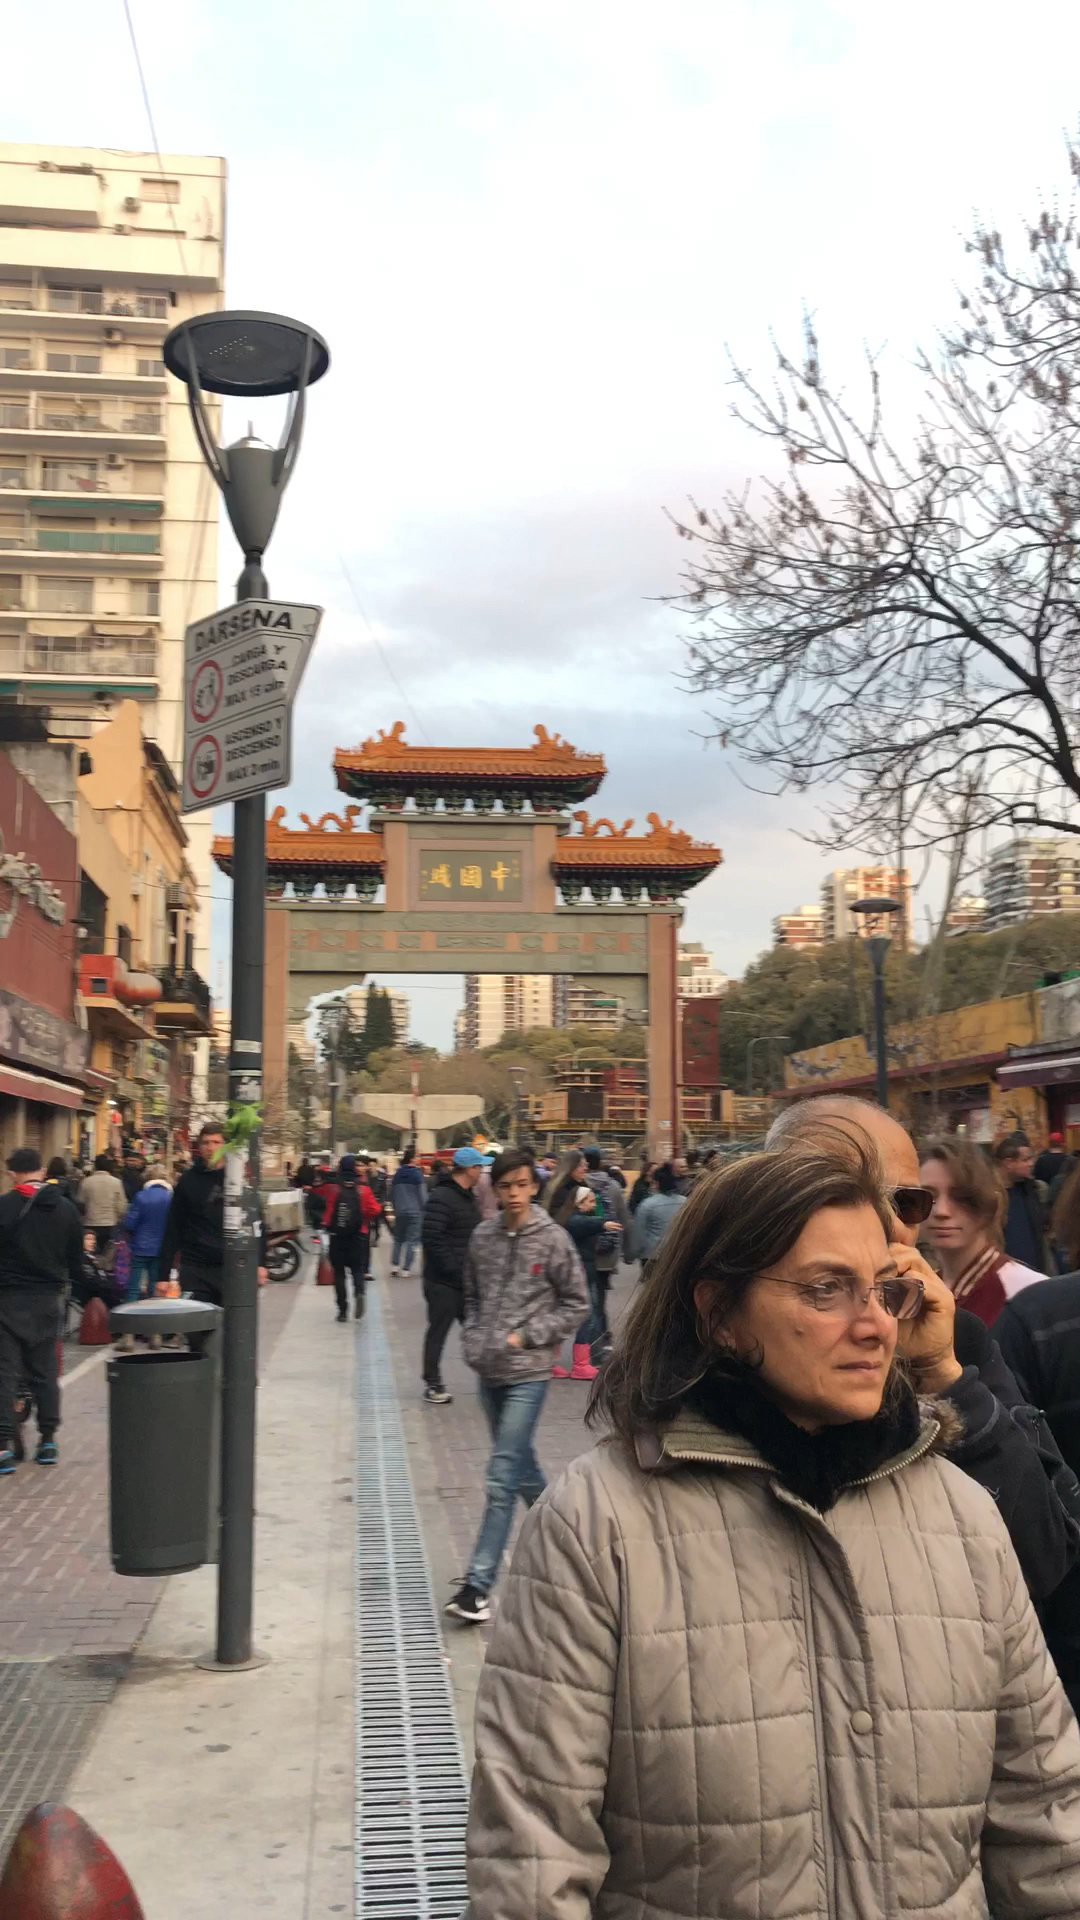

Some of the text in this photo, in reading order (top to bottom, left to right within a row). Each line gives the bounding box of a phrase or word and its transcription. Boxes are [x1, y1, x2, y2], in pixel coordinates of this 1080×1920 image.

[195, 608, 292, 652] DARSENA
[231, 644, 287, 667] CARGA Y
[227, 659, 288, 686] DESCARGA
[225, 720, 273, 745] ASCENSO
[226, 735, 281, 762] DESCENSO
